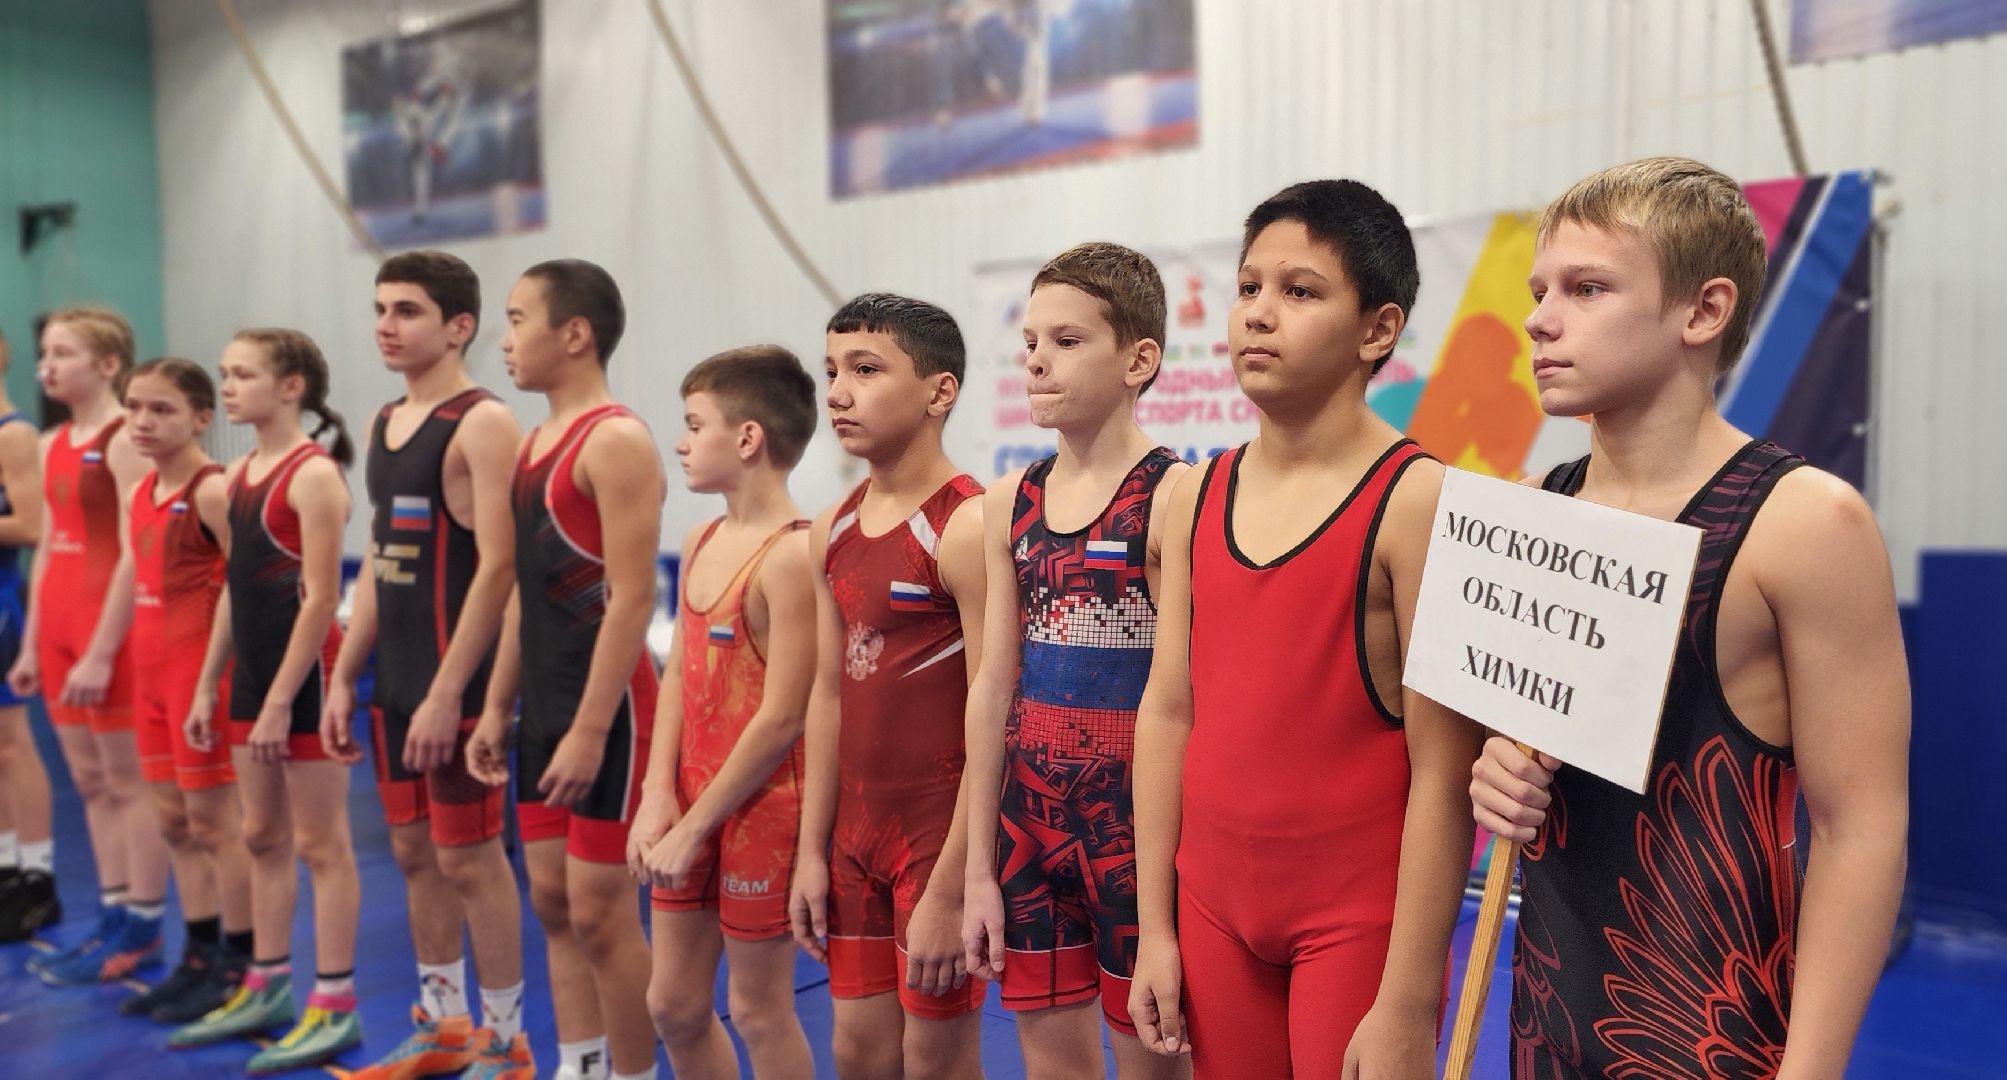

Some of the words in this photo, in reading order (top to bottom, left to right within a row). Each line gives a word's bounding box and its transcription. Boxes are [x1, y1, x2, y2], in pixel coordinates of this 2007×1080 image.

[1442, 511, 1670, 605] МОСКОВСКАЯ
[1462, 576, 1605, 650] ОБЛАСТЬ
[1460, 645, 1575, 718] ХИМКИ
[722, 875, 769, 893] TEAM
